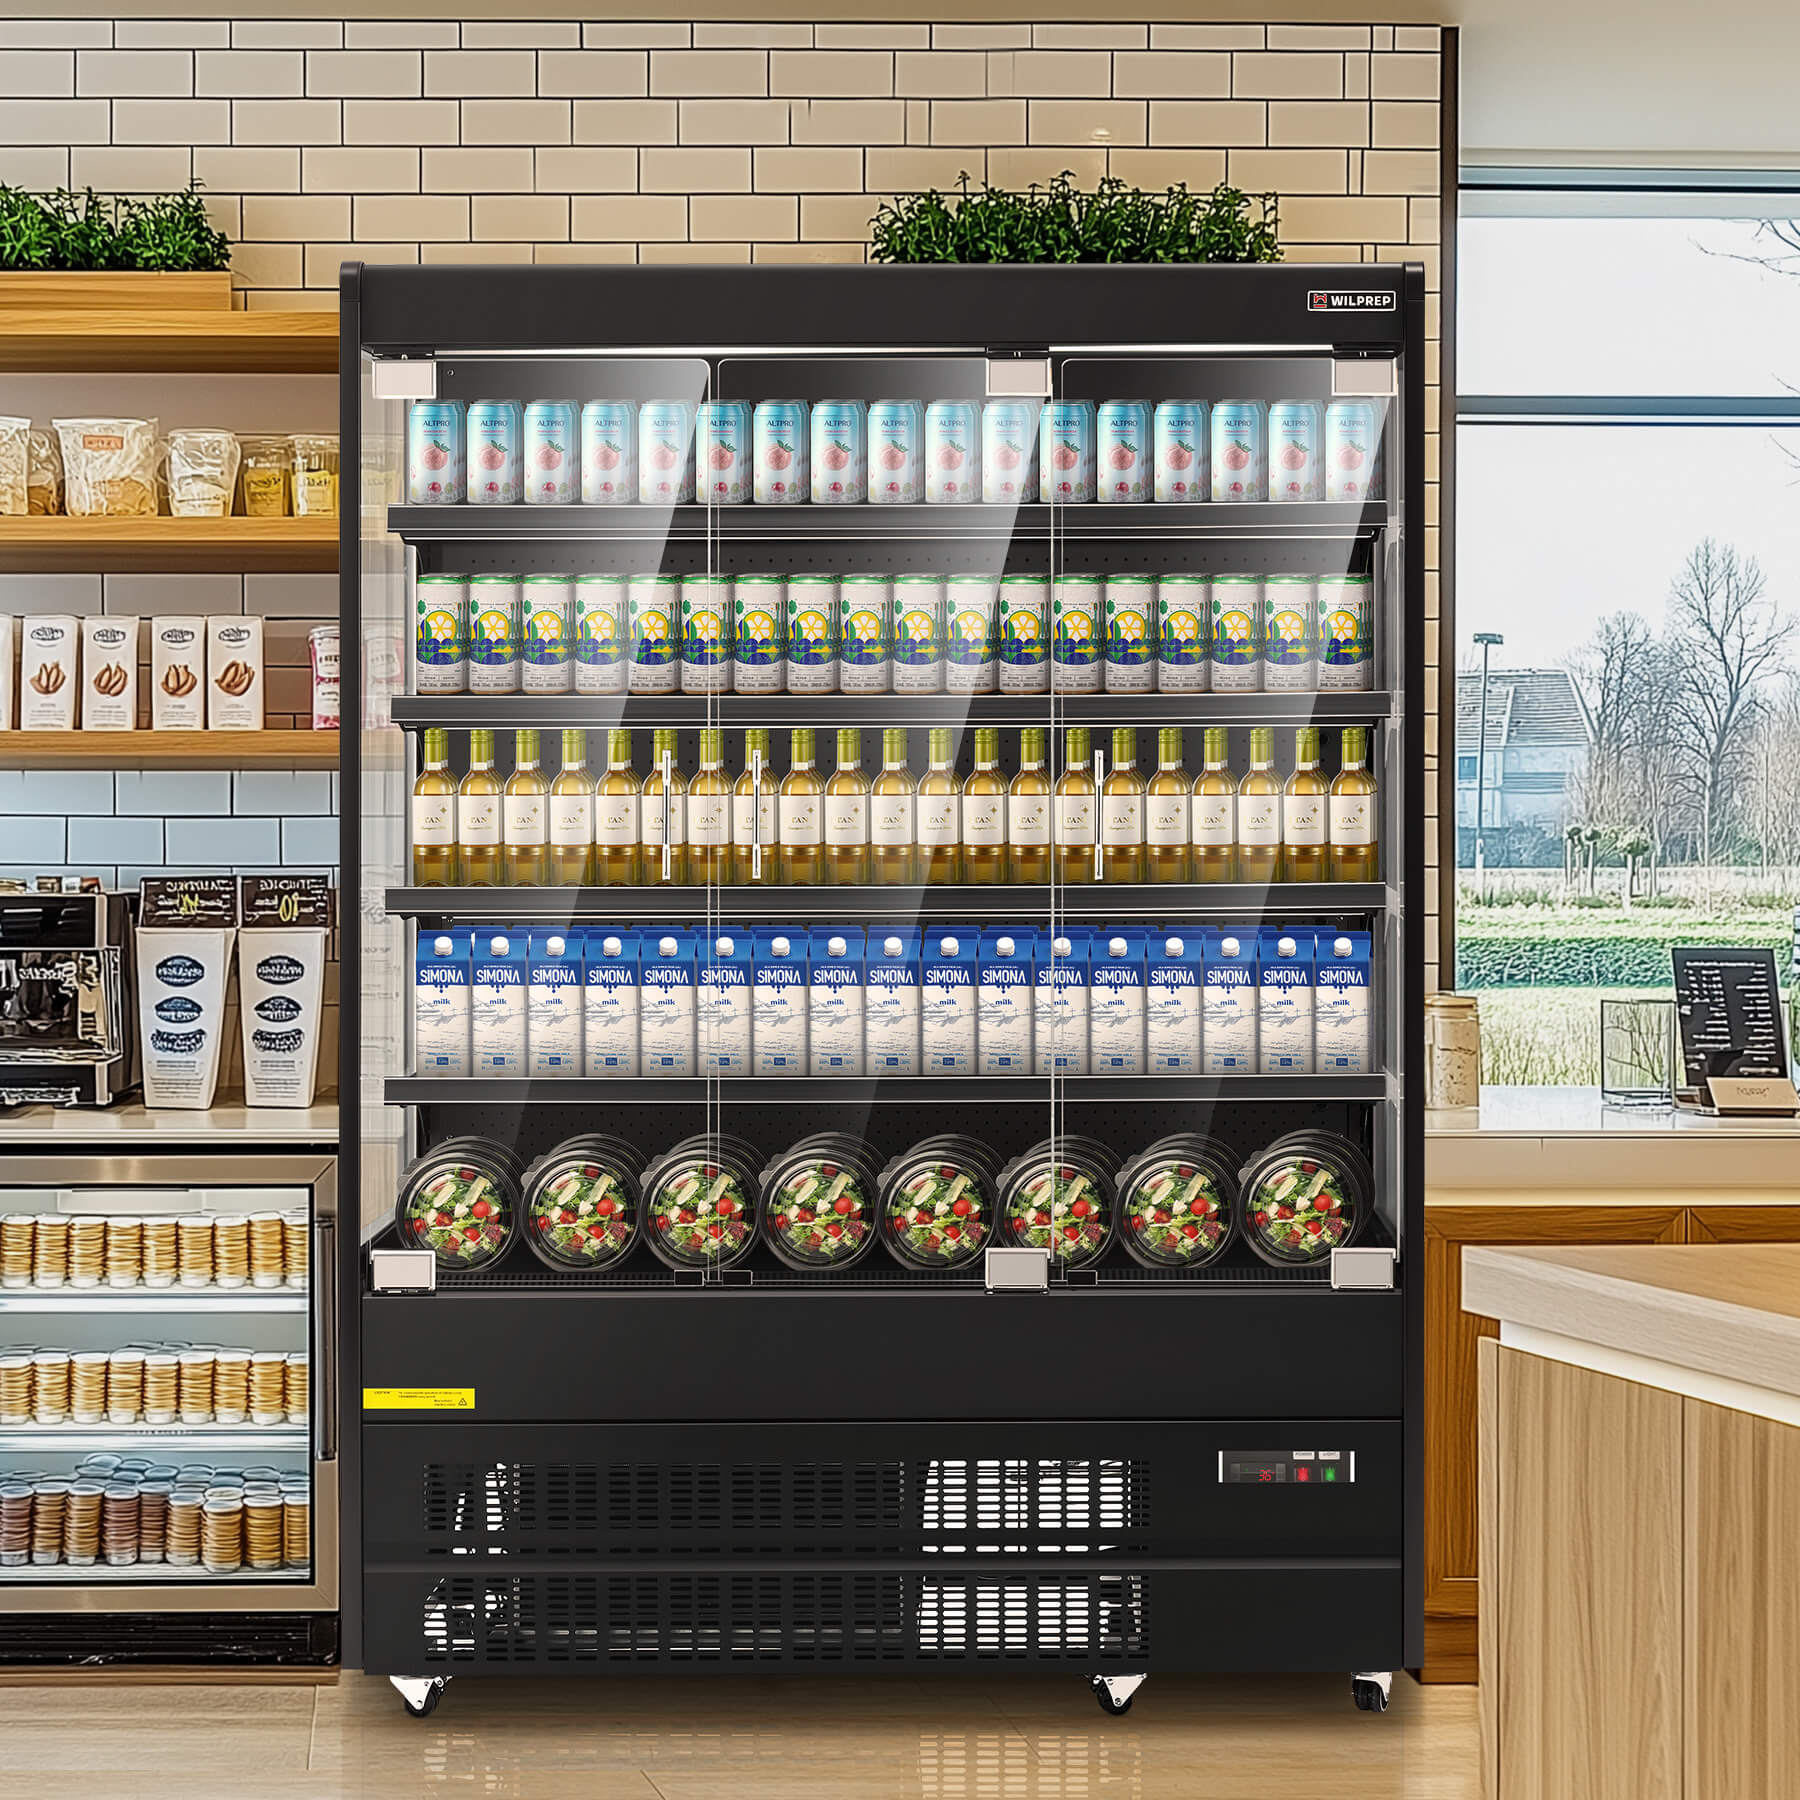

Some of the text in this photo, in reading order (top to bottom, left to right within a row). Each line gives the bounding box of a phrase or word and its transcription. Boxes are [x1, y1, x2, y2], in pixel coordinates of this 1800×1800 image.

[1331, 295, 1391, 306] WILPREP
[420, 969, 464, 983] SIMONA
[476, 969, 520, 983] SIMONA
[532, 969, 576, 983] SIMONA
[589, 969, 633, 983] SIMONA
[645, 969, 689, 983] SIMONA
[757, 969, 801, 983] SIMONA
[814, 969, 858, 983] SIMONA
[870, 970, 914, 984] SIMONA
[926, 969, 970, 983] SIMONA
[982, 969, 1026, 983] SIMONA
[1095, 970, 1139, 984] SIMONA
[1151, 970, 1195, 984] SIMONA
[1207, 970, 1251, 984] SIMONA
[1264, 970, 1308, 984] SIMONA
[1320, 970, 1364, 984] SIMONA
